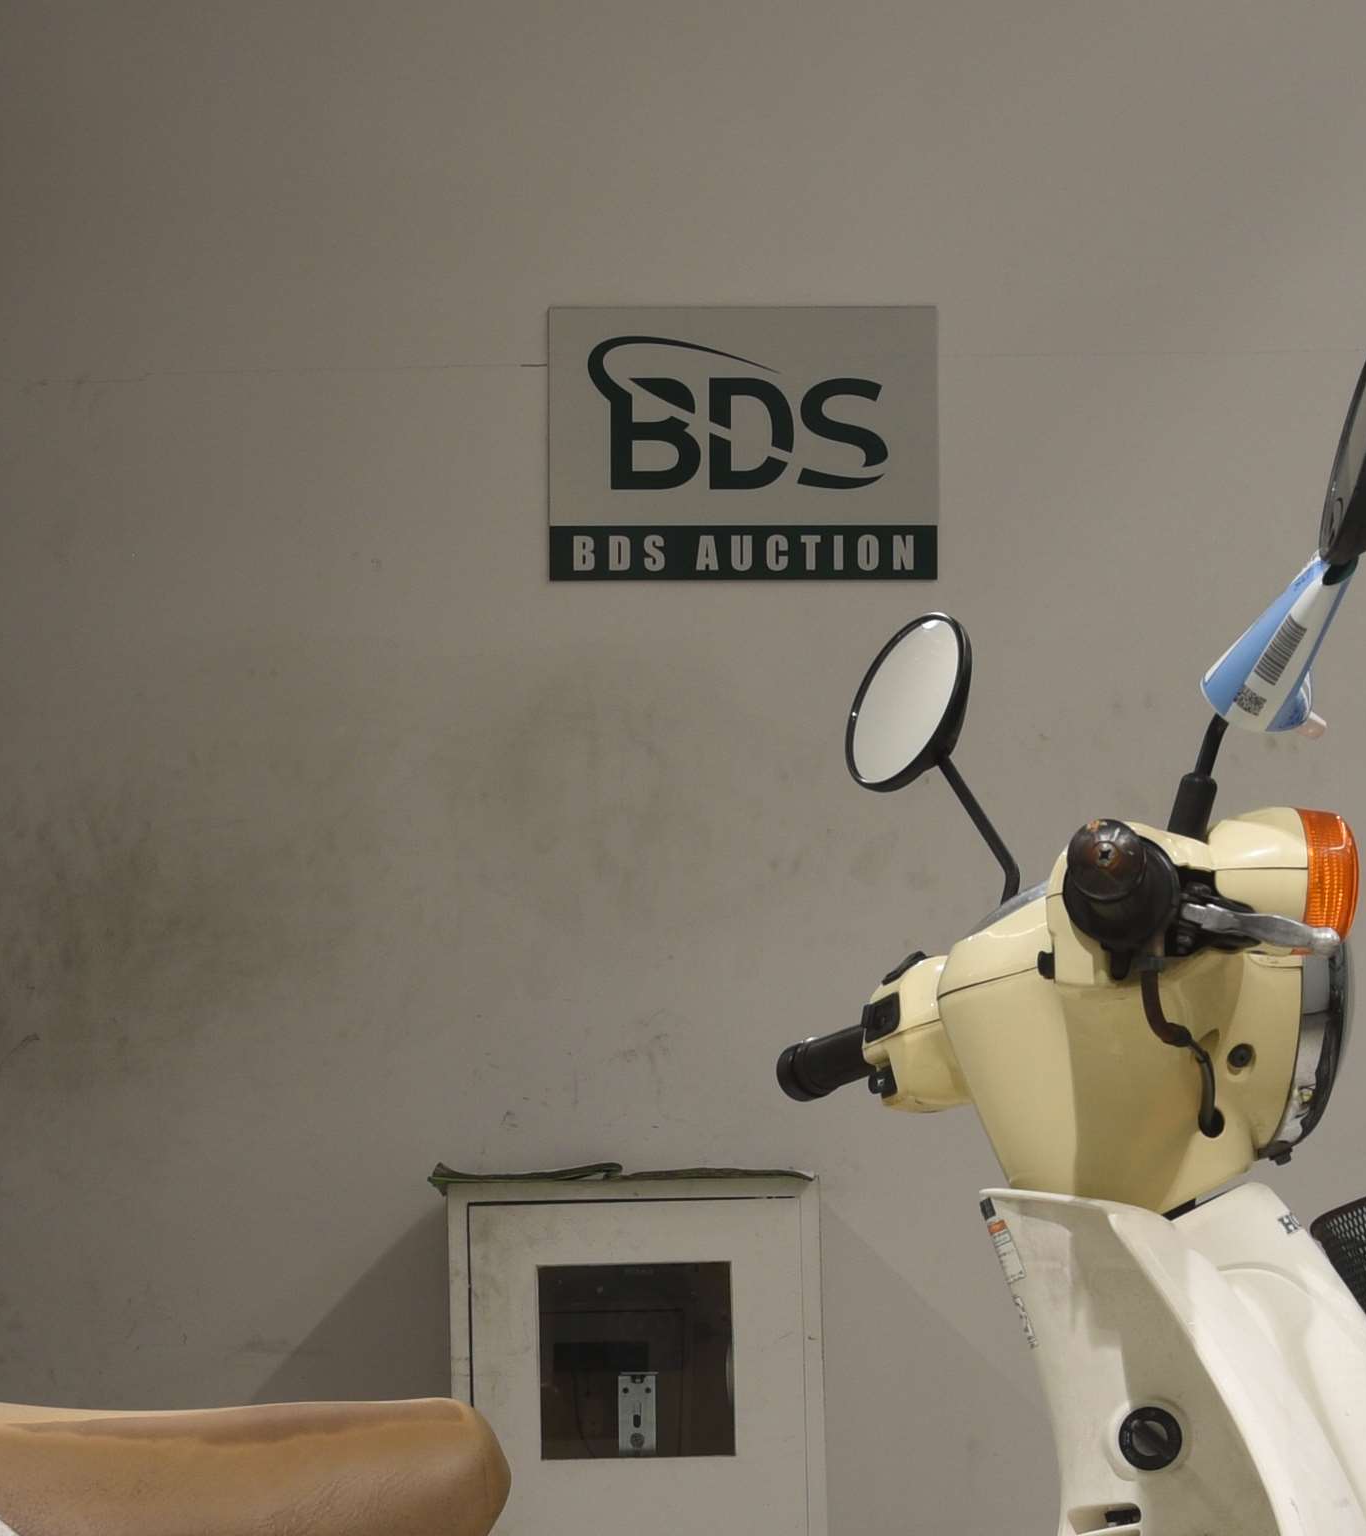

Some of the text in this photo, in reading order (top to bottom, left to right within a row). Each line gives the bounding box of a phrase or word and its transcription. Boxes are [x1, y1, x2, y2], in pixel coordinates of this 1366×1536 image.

[588, 336, 889, 490] BDS
[572, 534, 916, 572] BDS AUCTION
